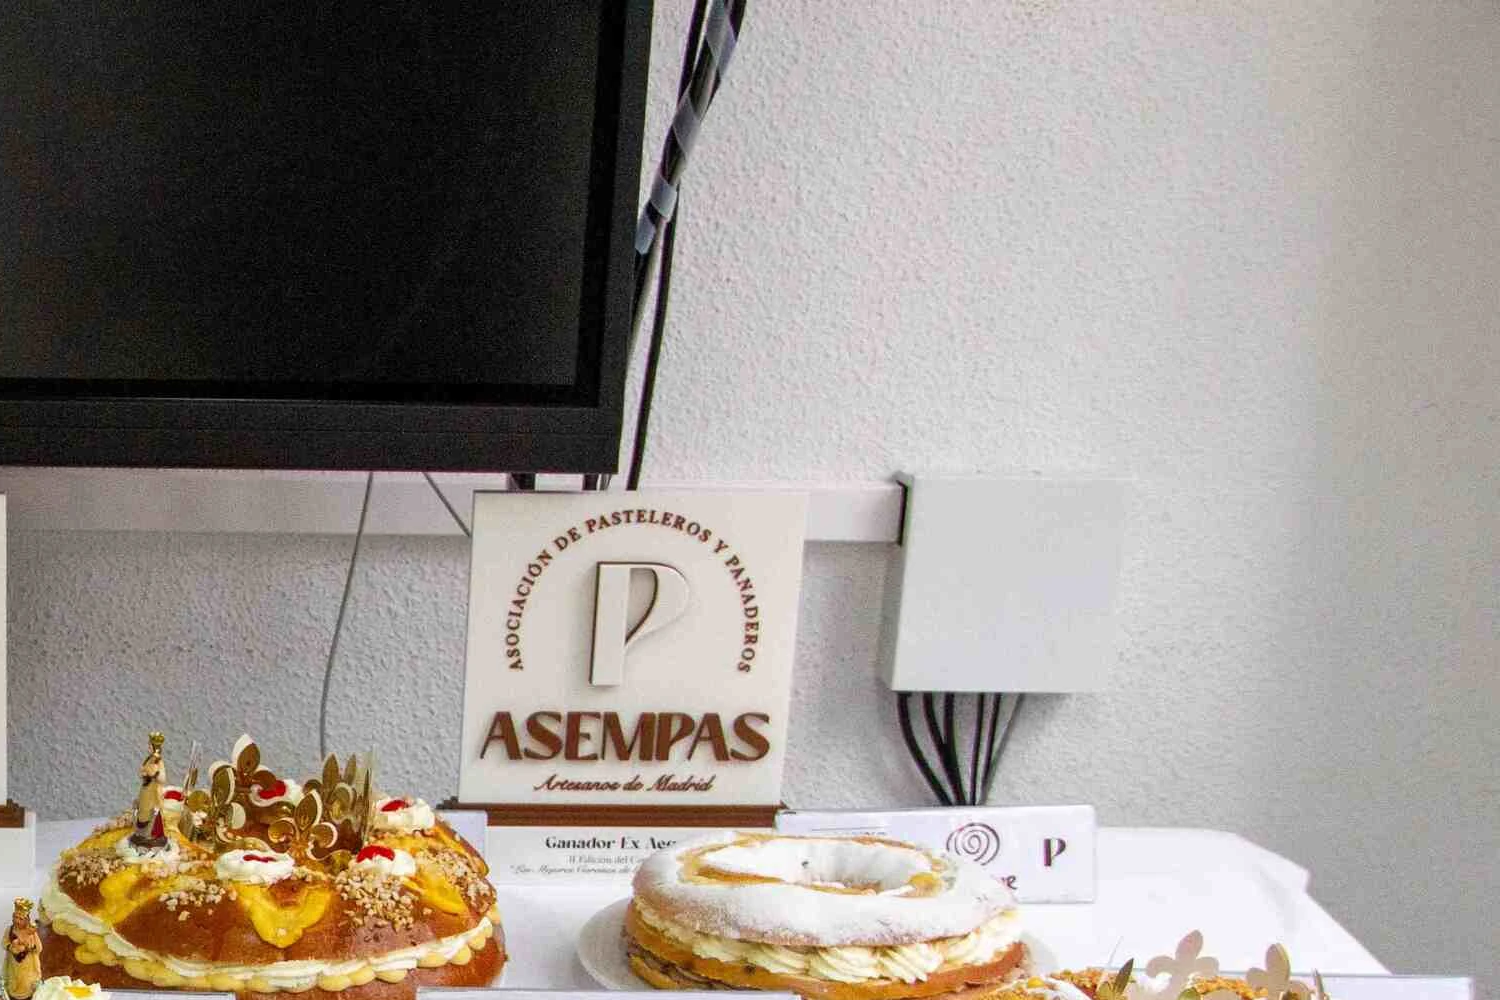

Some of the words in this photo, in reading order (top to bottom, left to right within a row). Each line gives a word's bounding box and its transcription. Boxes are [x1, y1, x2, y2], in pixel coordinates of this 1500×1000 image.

[505, 549, 553, 672] ASOCIACIÓN
[554, 527, 582, 552] DE
[585, 509, 712, 543] PASTELEROS
[714, 539, 729, 555] Y
[724, 554, 760, 674] PANADEROS
[589, 561, 692, 686] P
[480, 711, 770, 761] ASEMPAS
[533, 774, 620, 792] Artesanos
[622, 775, 643, 792] de
[646, 774, 716, 792] Madrid
[545, 836, 616, 849] Ganador
[620, 836, 640, 849] Ex
[1043, 838, 1066, 867] P
